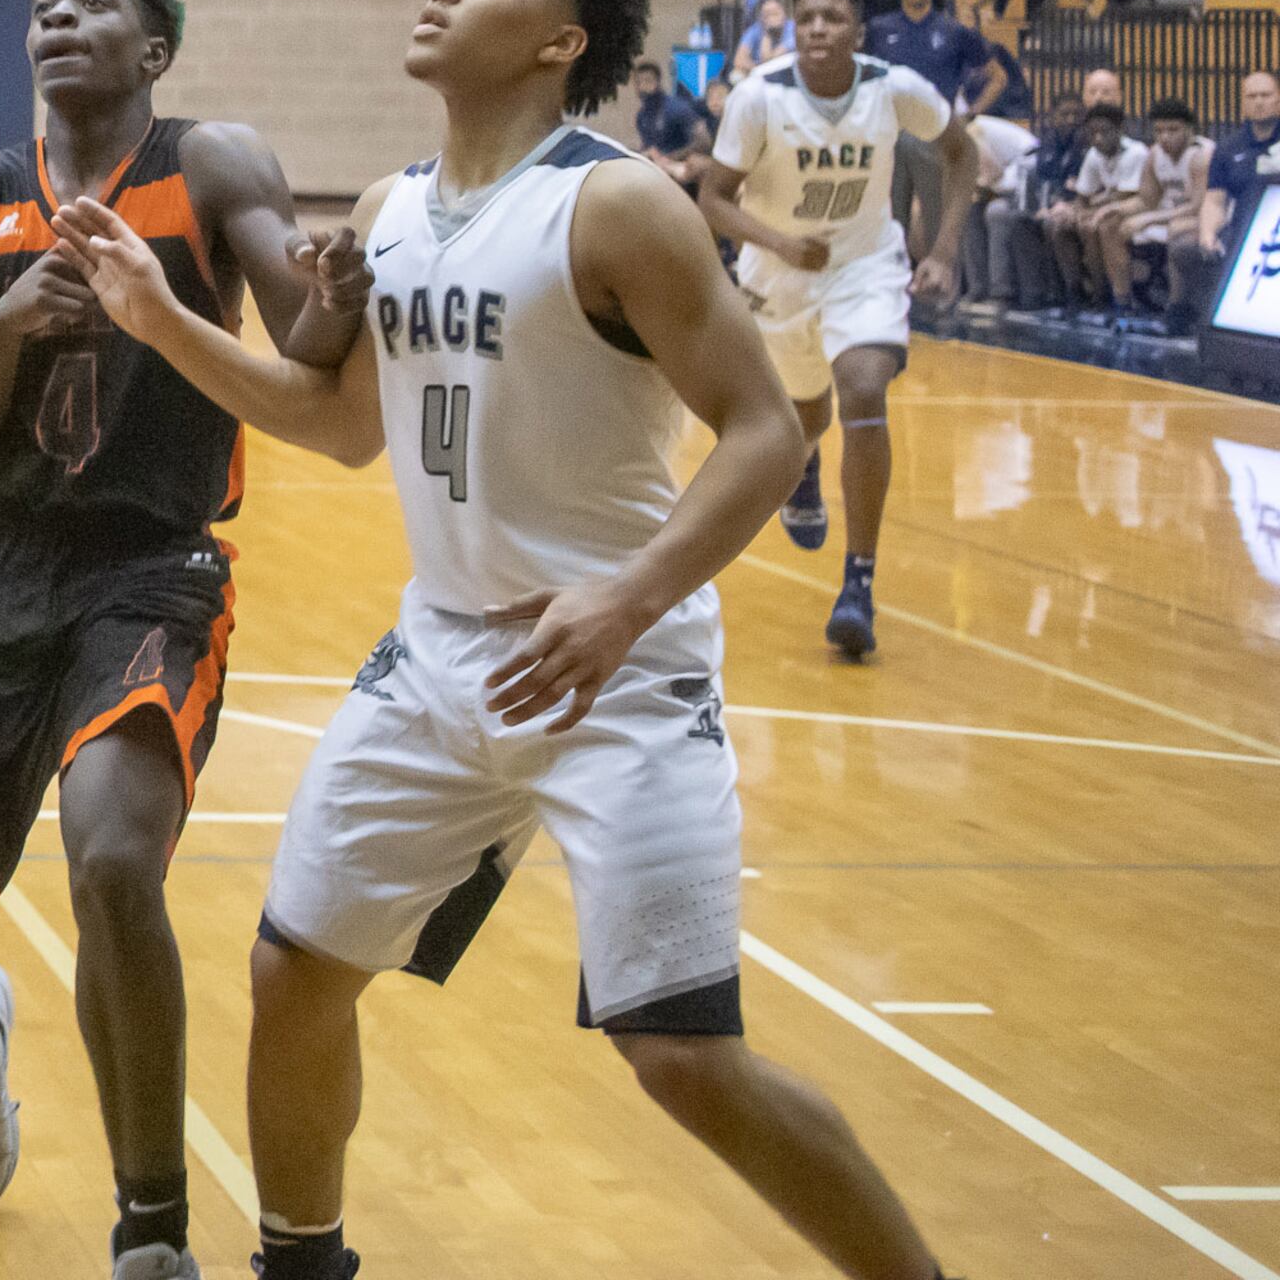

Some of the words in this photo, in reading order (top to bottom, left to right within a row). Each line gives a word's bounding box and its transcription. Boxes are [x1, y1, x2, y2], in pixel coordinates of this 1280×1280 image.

[795, 143, 876, 172] PACE
[376, 283, 507, 362] PACE
[36, 351, 102, 476] 4
[420, 383, 471, 504] 4
